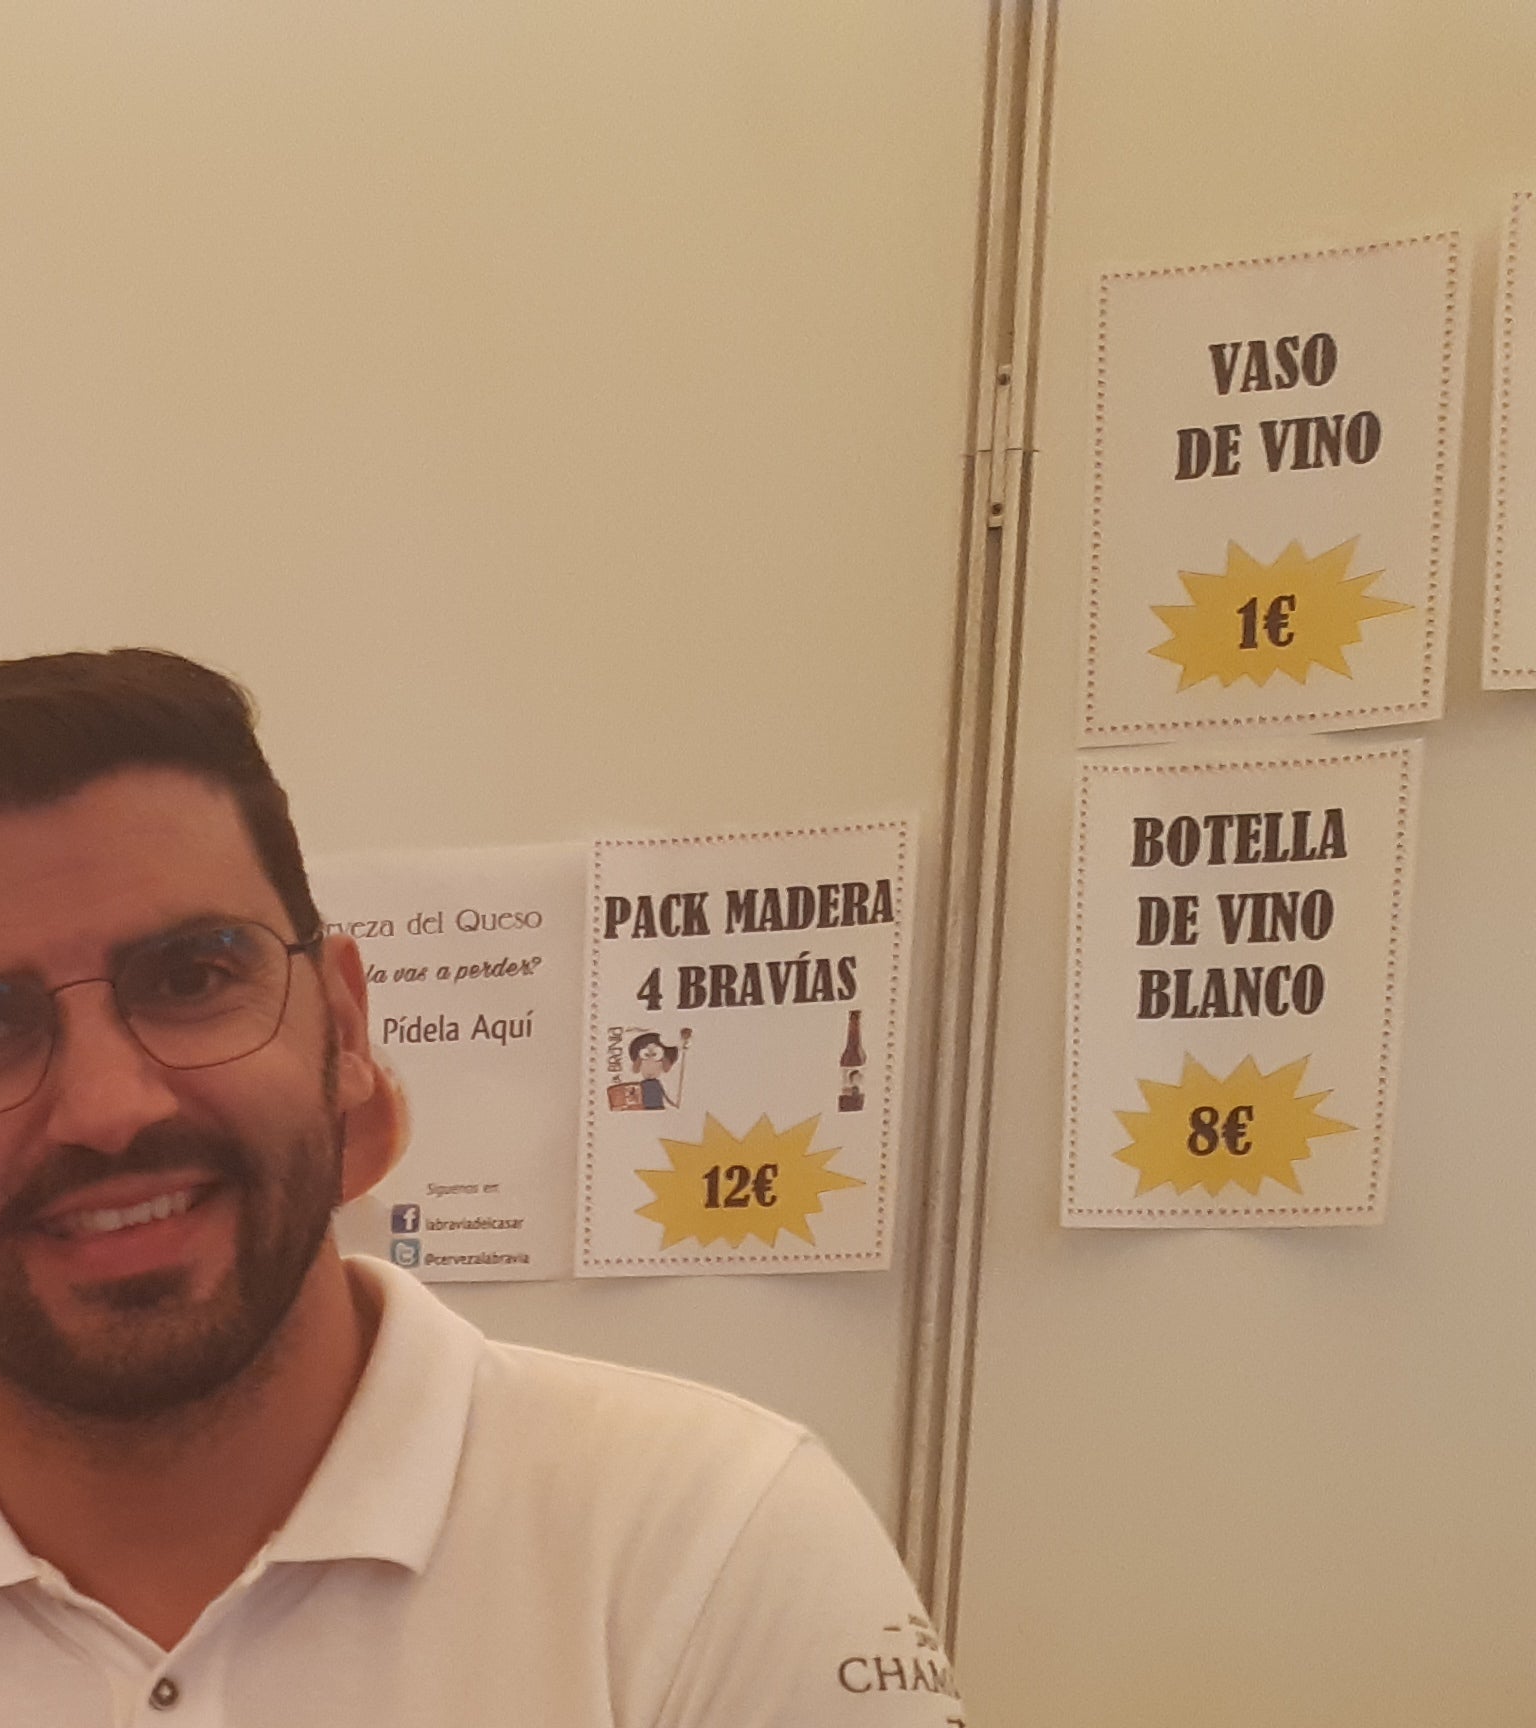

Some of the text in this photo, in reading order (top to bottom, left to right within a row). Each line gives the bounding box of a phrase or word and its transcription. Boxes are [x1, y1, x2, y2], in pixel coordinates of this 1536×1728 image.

[1208, 332, 1339, 396] VASO
[1174, 409, 1382, 481] DE VINO
[1235, 594, 1297, 650] 1€
[1130, 807, 1349, 868] BOTELLA
[327, 908, 544, 940] rveza del Queso
[602, 878, 895, 940] PACK MADERA
[1135, 888, 1336, 947] DE VINO
[393, 964, 428, 984] vas
[436, 965, 451, 980] a
[454, 956, 543, 985] perder?
[636, 951, 859, 1011] 4 BRAVÍAS
[1136, 963, 1326, 1020] BLANCO
[383, 1009, 534, 1047] Pídela Aquí
[1186, 1104, 1255, 1157] 8€
[702, 1163, 780, 1210] 12€
